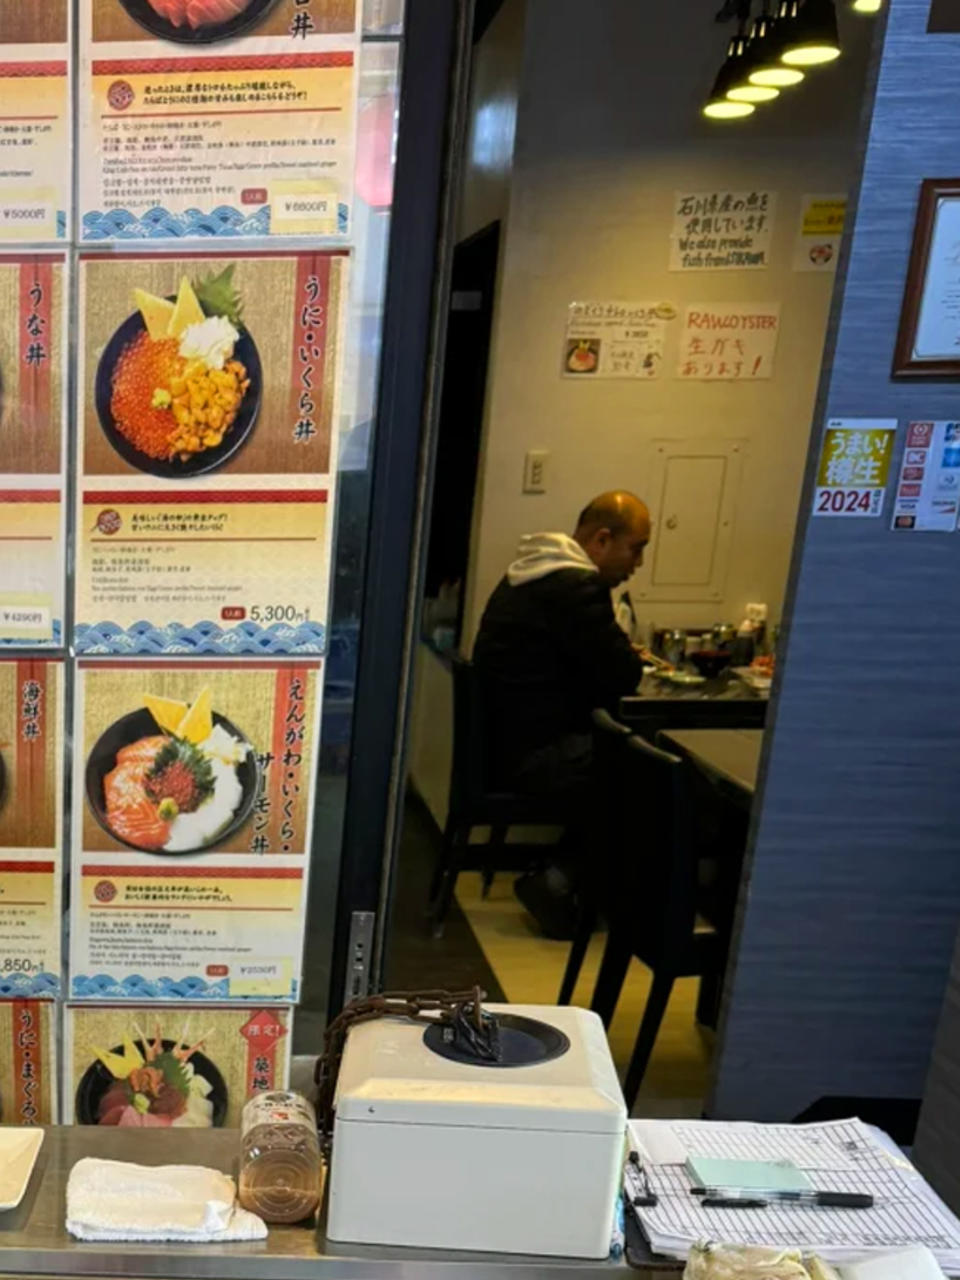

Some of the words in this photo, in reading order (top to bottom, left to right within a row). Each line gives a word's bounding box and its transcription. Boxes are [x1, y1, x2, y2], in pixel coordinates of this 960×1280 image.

[25, 283, 47, 367] うな丼
[293, 277, 321, 443] うに・いくら丼
[817, 489, 872, 512] 2024
[23, 681, 41, 739] 海鮮丼
[250, 752, 275, 854] サーモン丼
